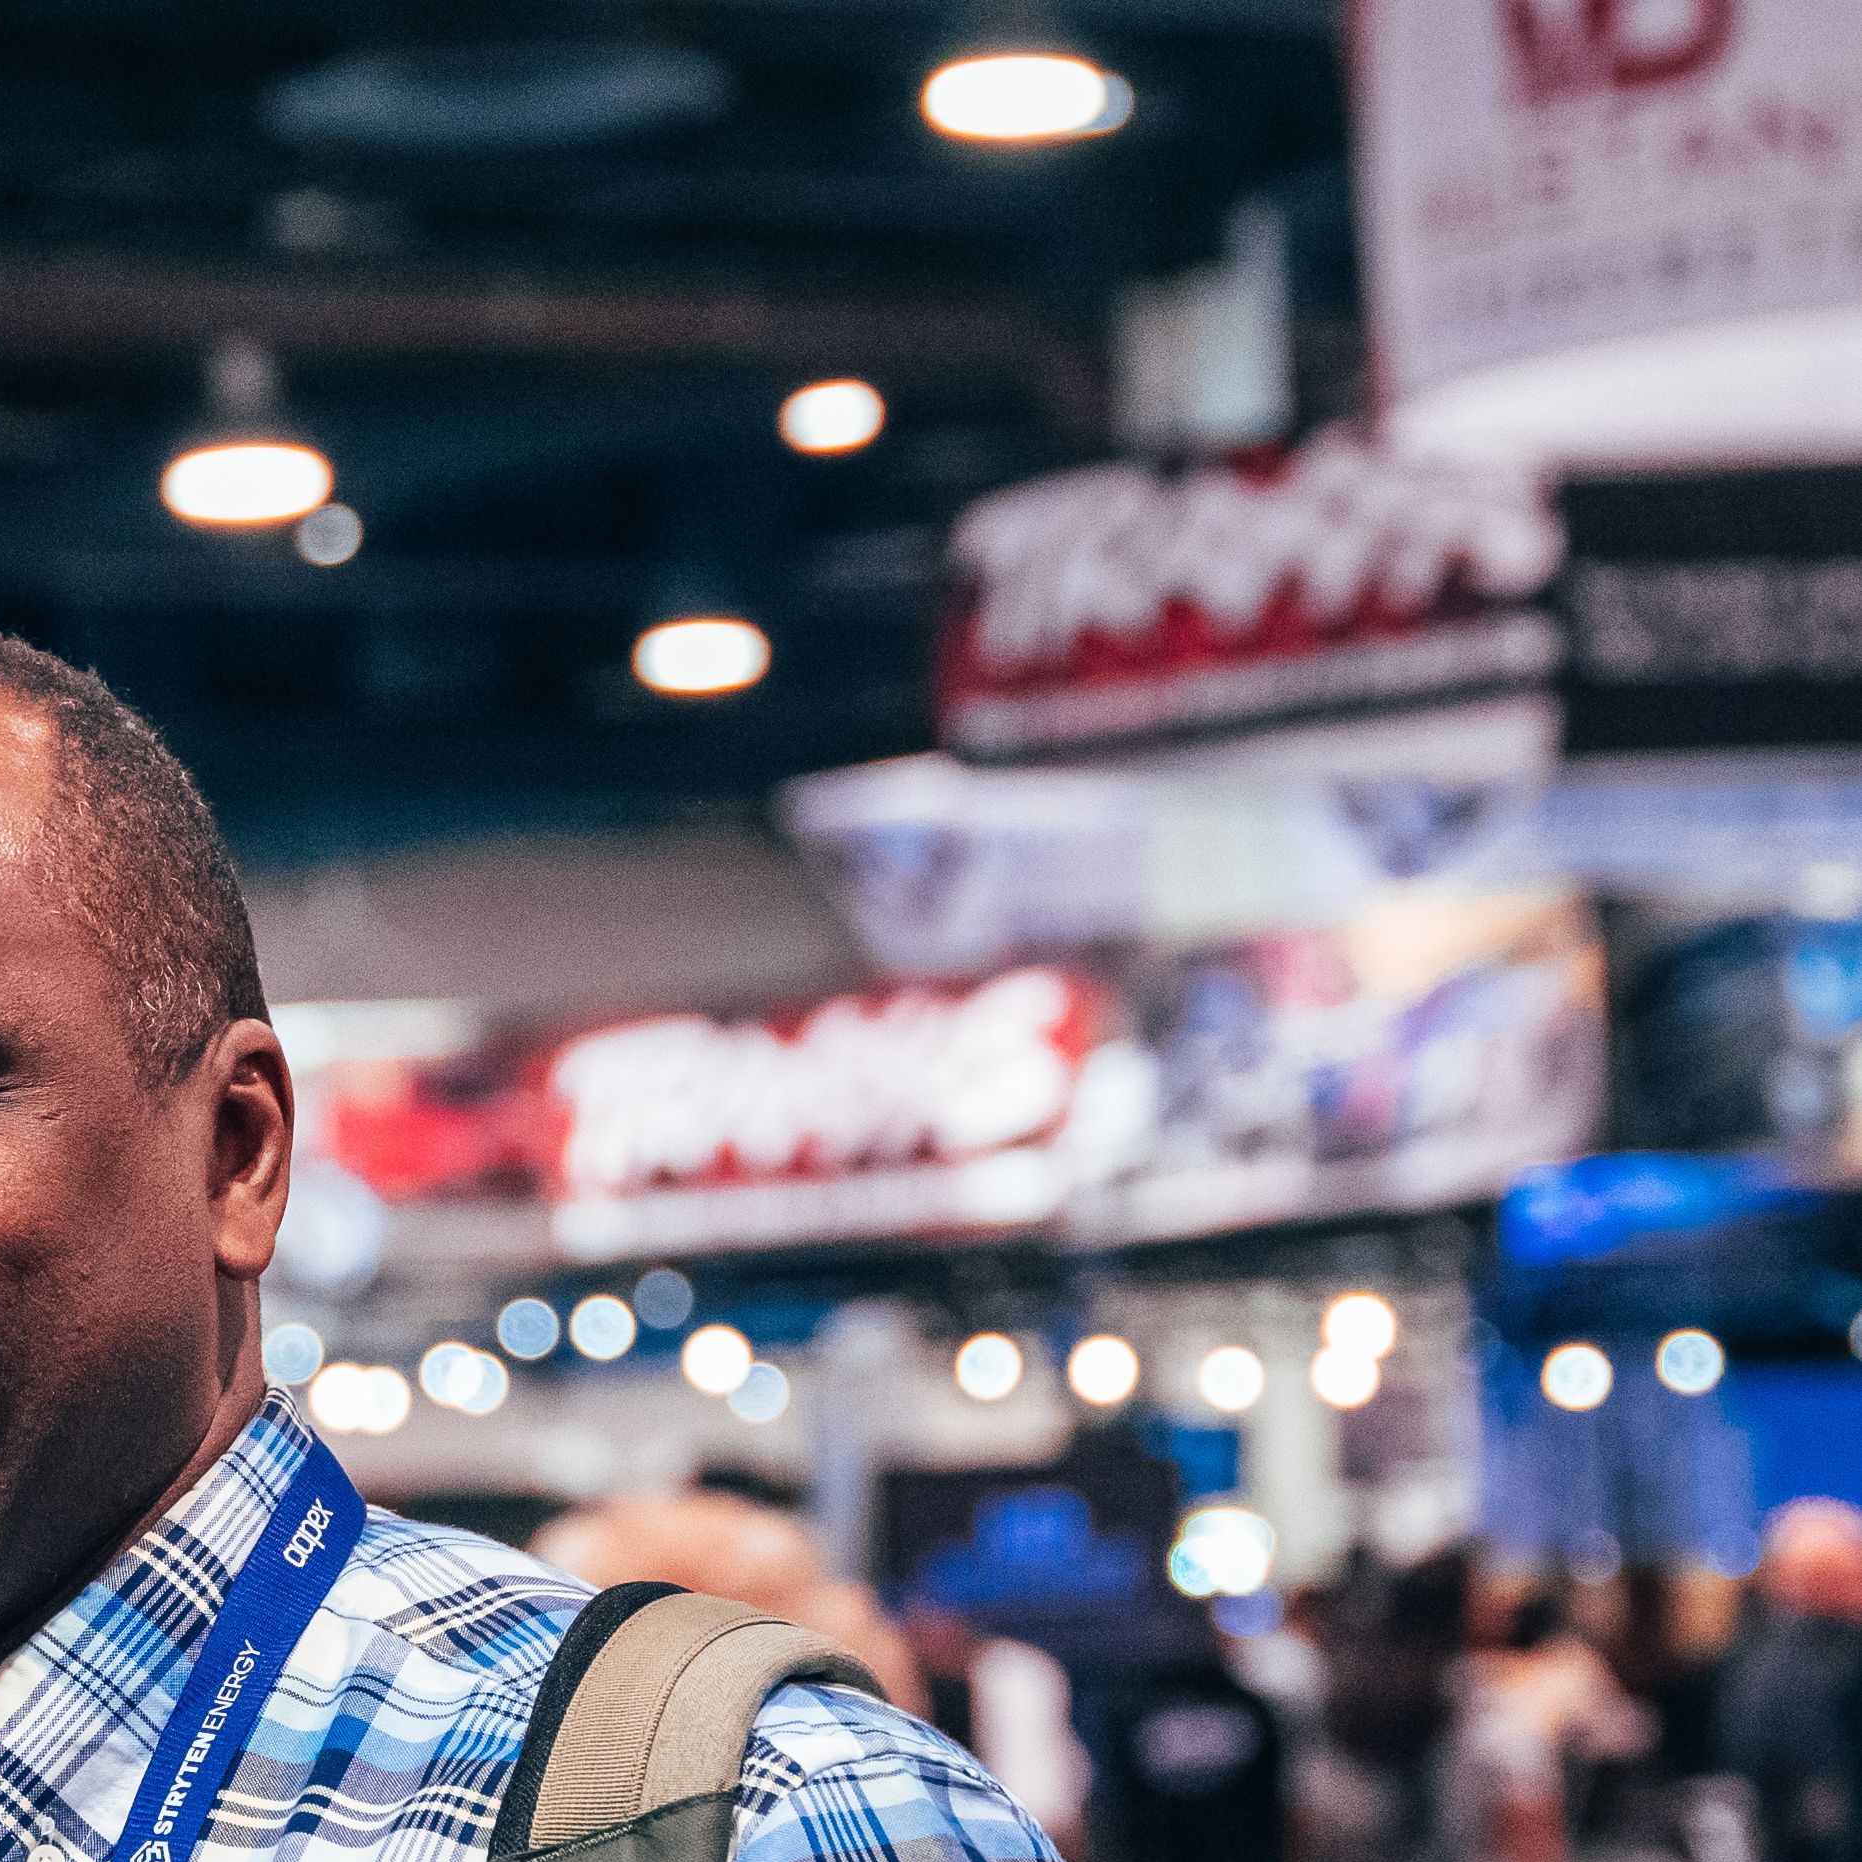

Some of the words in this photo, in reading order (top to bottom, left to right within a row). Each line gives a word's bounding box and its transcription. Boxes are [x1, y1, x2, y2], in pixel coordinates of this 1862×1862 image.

[283, 1497, 334, 1569] aapex
[153, 1734, 215, 1835] STRYTEN
[203, 1639, 262, 1731] ENERGY
